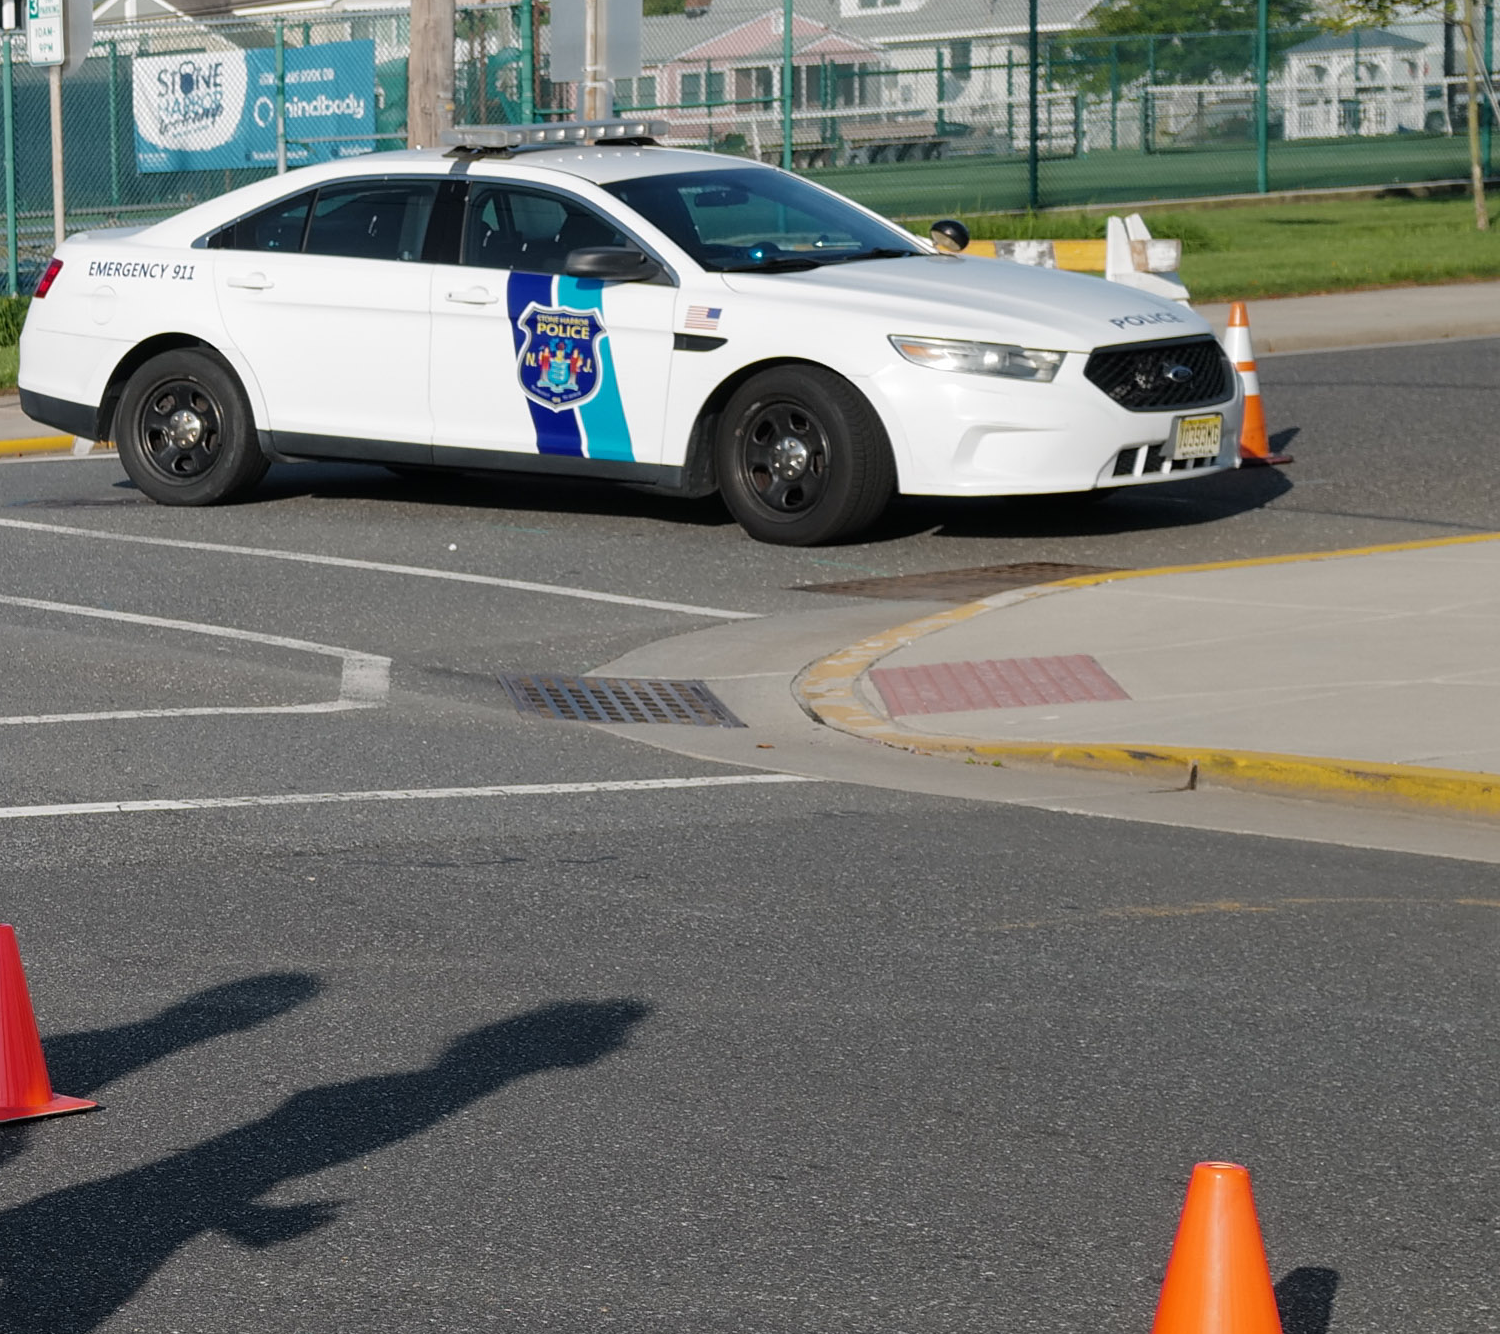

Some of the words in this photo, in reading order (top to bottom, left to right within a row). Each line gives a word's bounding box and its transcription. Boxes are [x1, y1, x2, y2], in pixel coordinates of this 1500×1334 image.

[88, 261, 169, 279] EMERGENCY
[171, 265, 195, 280] 911
[537, 314, 559, 324] STONE
[560, 316, 589, 327] HARBOR
[1109, 312, 1185, 329] POLICE
[536, 323, 590, 339] POLICE
